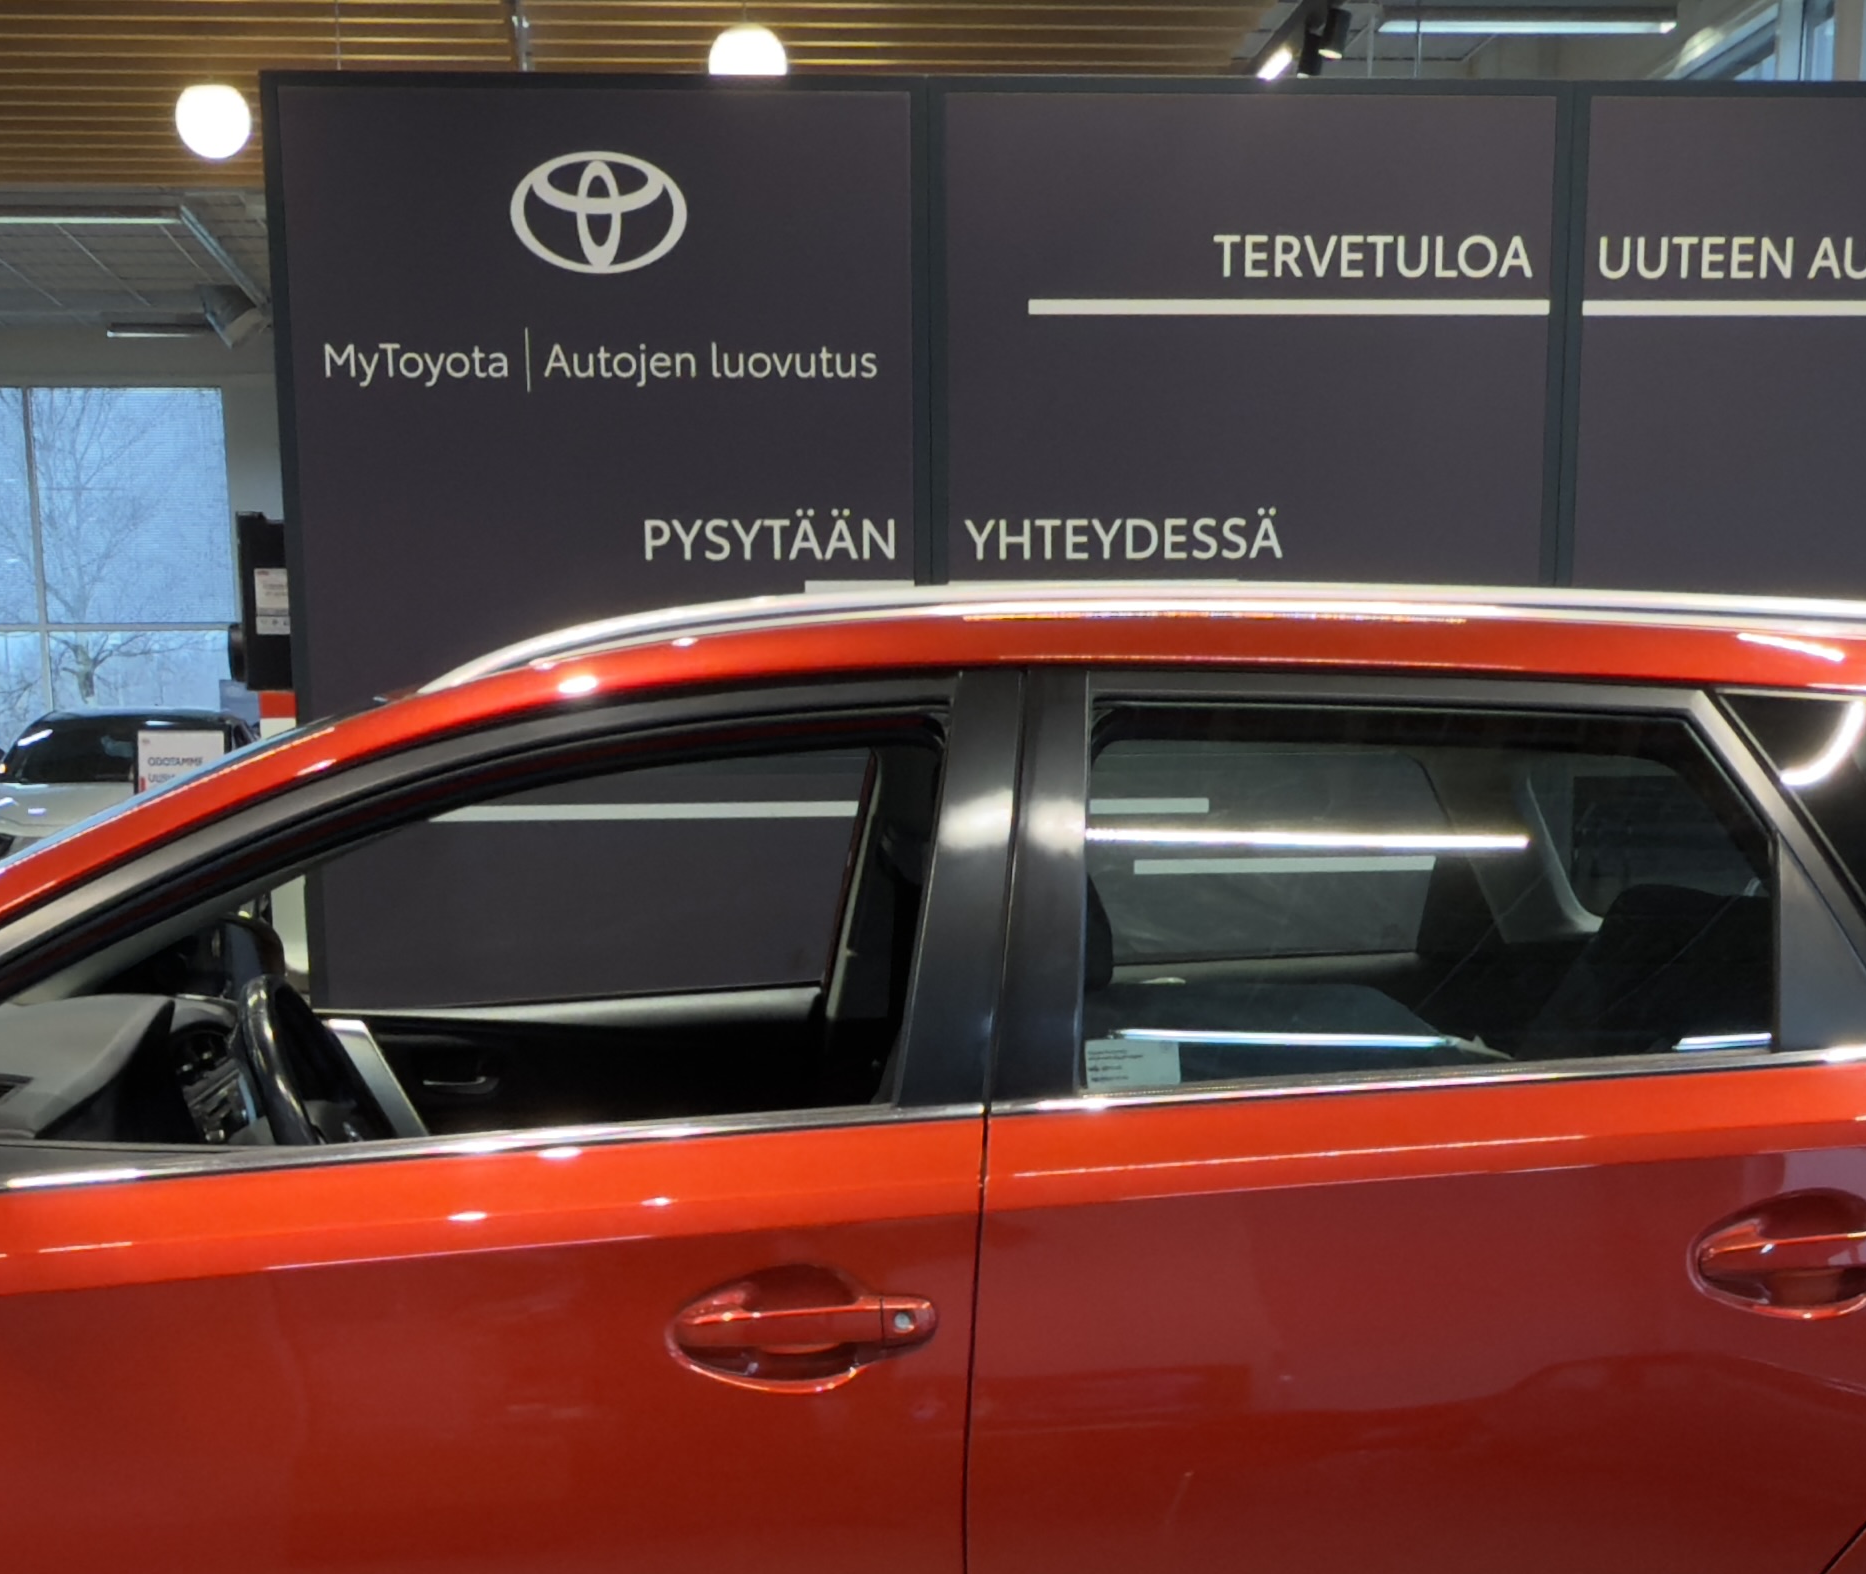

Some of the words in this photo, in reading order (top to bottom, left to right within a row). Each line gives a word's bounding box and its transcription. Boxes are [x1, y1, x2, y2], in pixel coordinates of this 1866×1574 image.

[1213, 233, 1533, 280] TERVETULOA
[1598, 235, 1794, 280] UUTEEN
[324, 343, 509, 387] MyToyota
[544, 343, 696, 387] Autojen
[711, 342, 878, 379] luovutus
[643, 508, 896, 561] PYSYTÄÄN
[964, 506, 1283, 561] YHTEYDESSÄ
